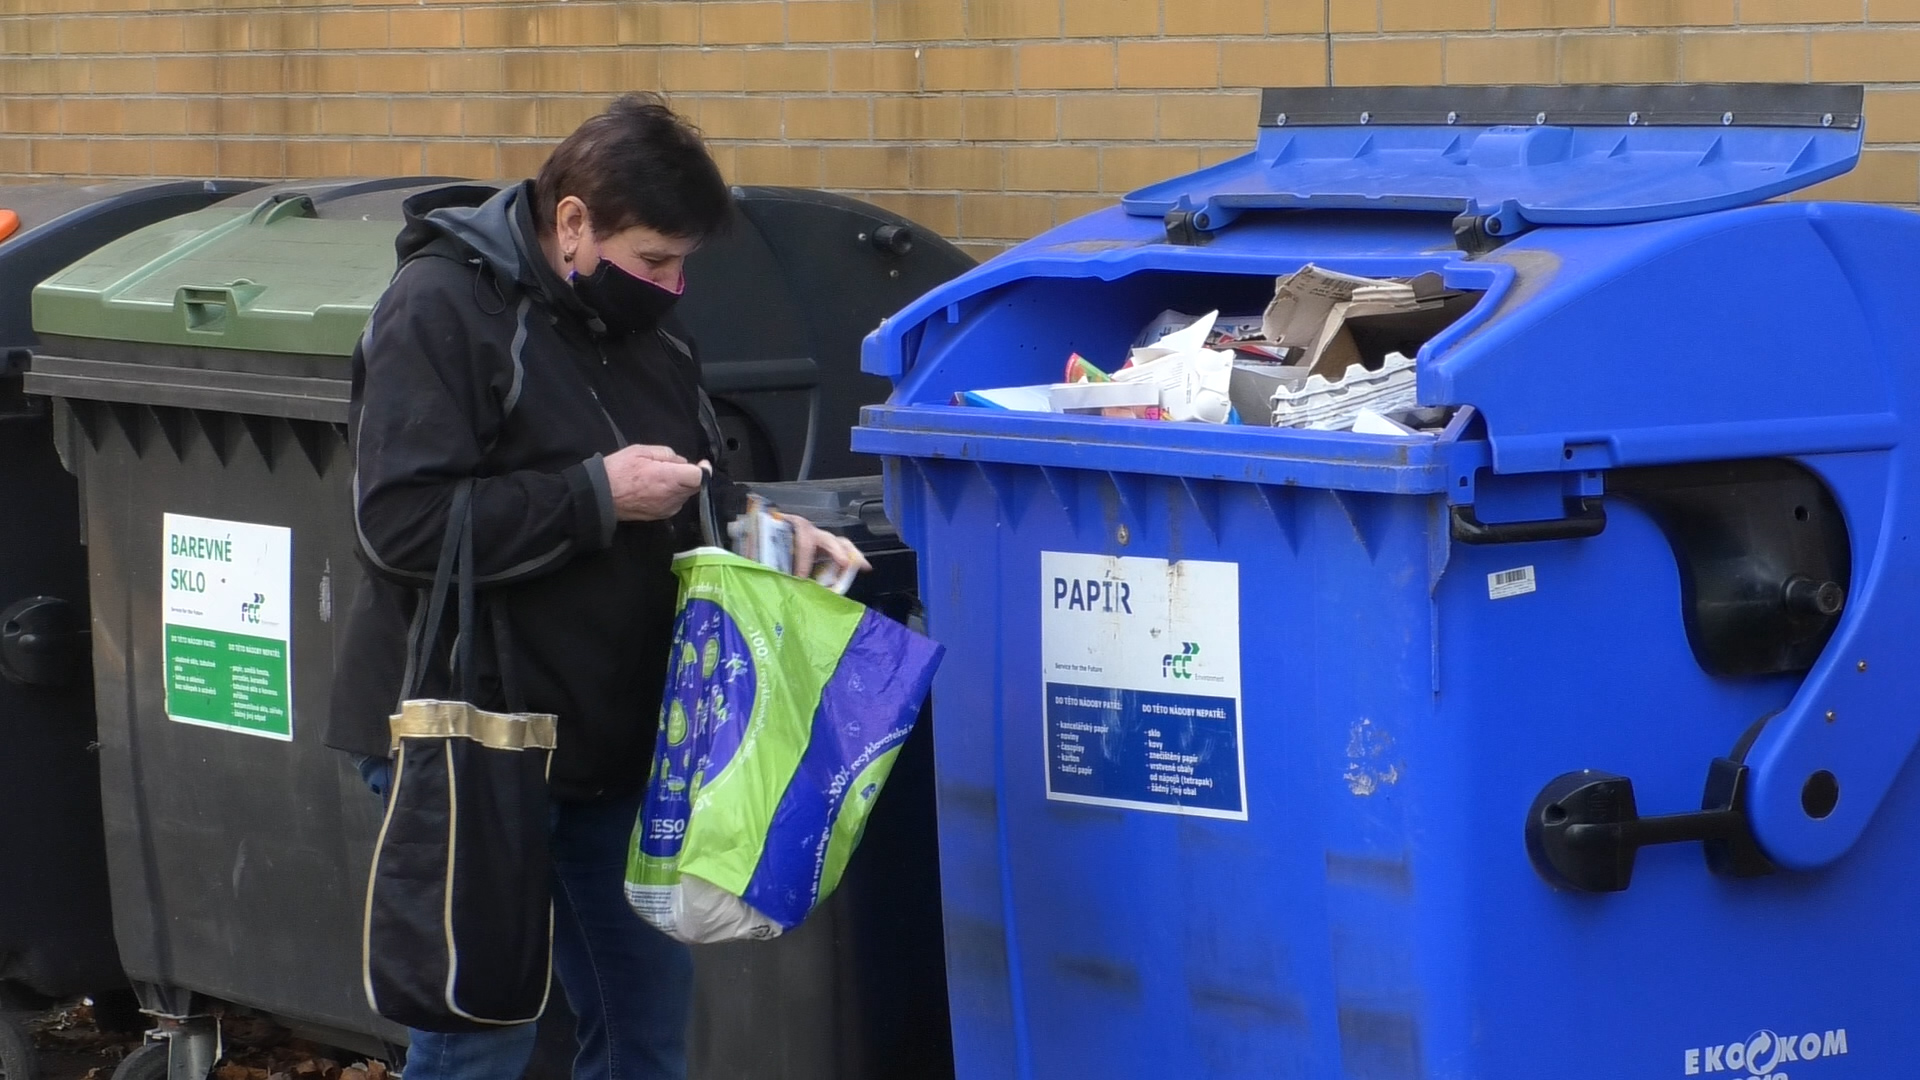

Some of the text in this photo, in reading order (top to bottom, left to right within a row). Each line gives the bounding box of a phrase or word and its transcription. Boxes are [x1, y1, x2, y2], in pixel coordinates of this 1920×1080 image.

[171, 533, 232, 562] BAREVNÉ
[170, 568, 206, 593] SKLO
[1054, 570, 1132, 614] PAPÍR
[1055, 662, 1103, 673] Service for the Future
[1163, 654, 1192, 679] FCC
[1055, 696, 1064, 704] DO
[1064, 695, 1078, 706] TÉTO
[1079, 697, 1102, 708] NÁDOBY
[1142, 703, 1227, 719] DO TÉTO NÁDOBY NEPATŘÍ:
[1148, 728, 1161, 738] sklo
[1148, 739, 1163, 750] kovy
[1149, 773, 1158, 781] od
